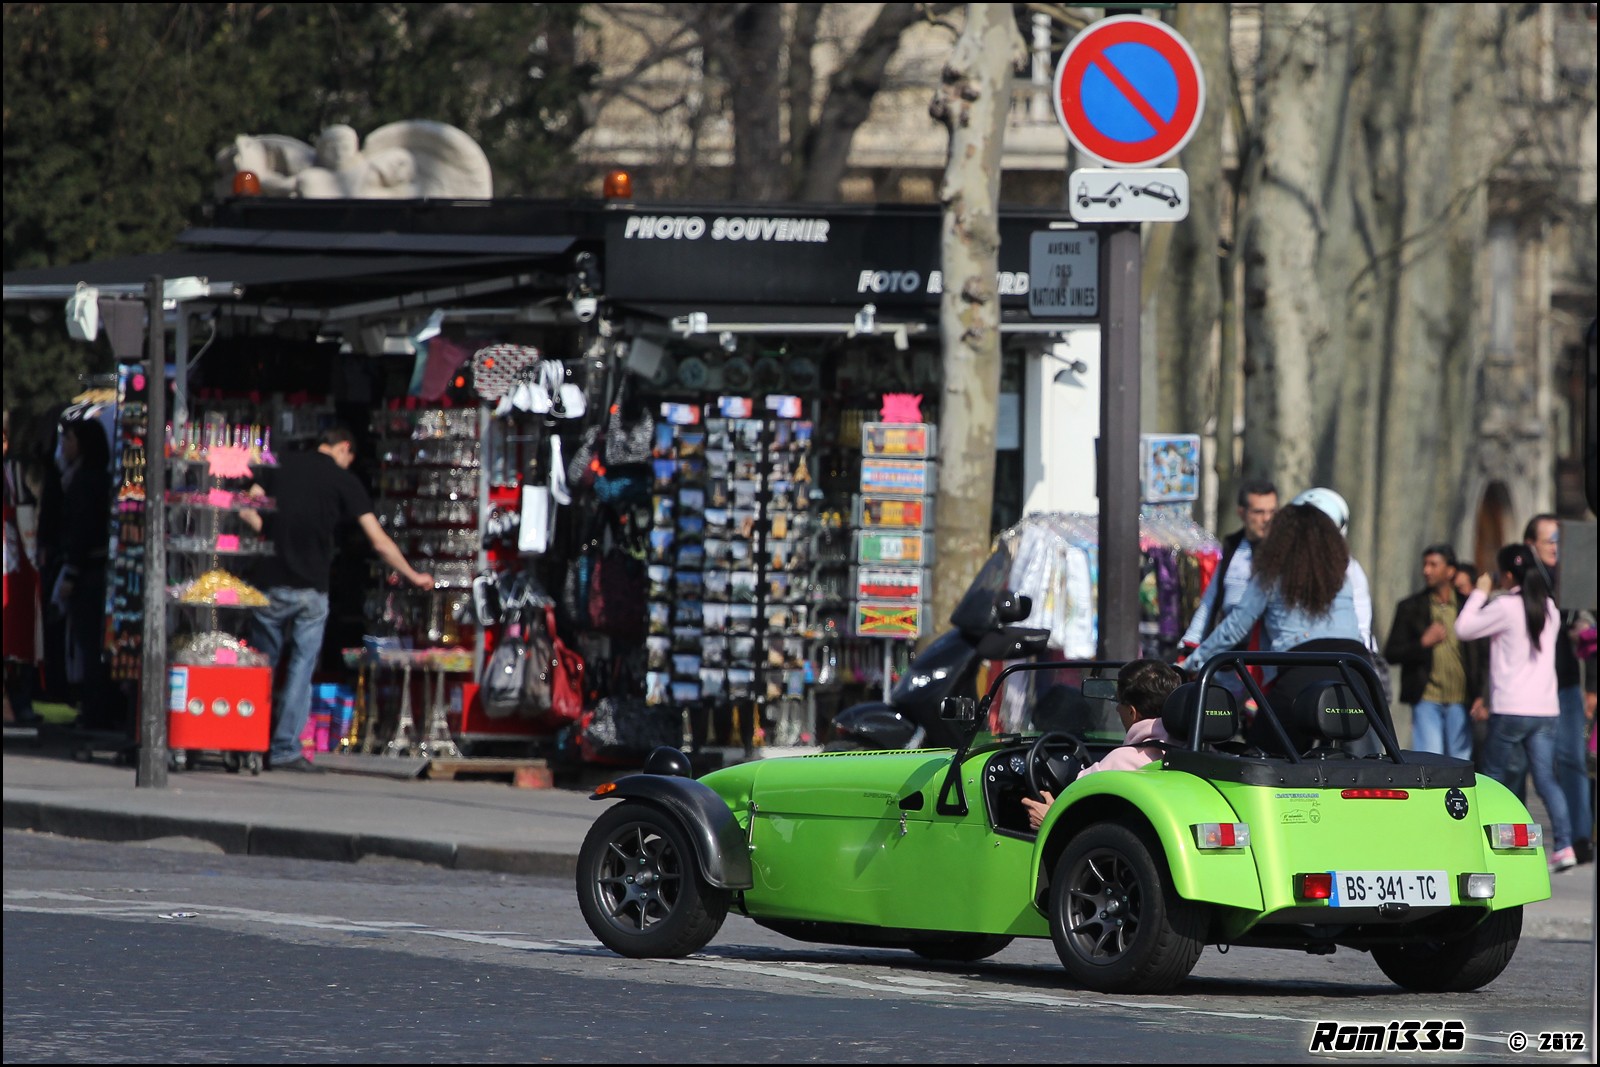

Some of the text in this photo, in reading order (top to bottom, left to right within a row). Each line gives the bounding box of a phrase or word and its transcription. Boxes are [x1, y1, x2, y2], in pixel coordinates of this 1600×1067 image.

[624, 215, 830, 243] PHOTO SOUVENIR
[1047, 241, 1081, 255] AVENUE
[857, 270, 921, 294] FOTO
[1032, 287, 1095, 307] NATIONS UNIES
